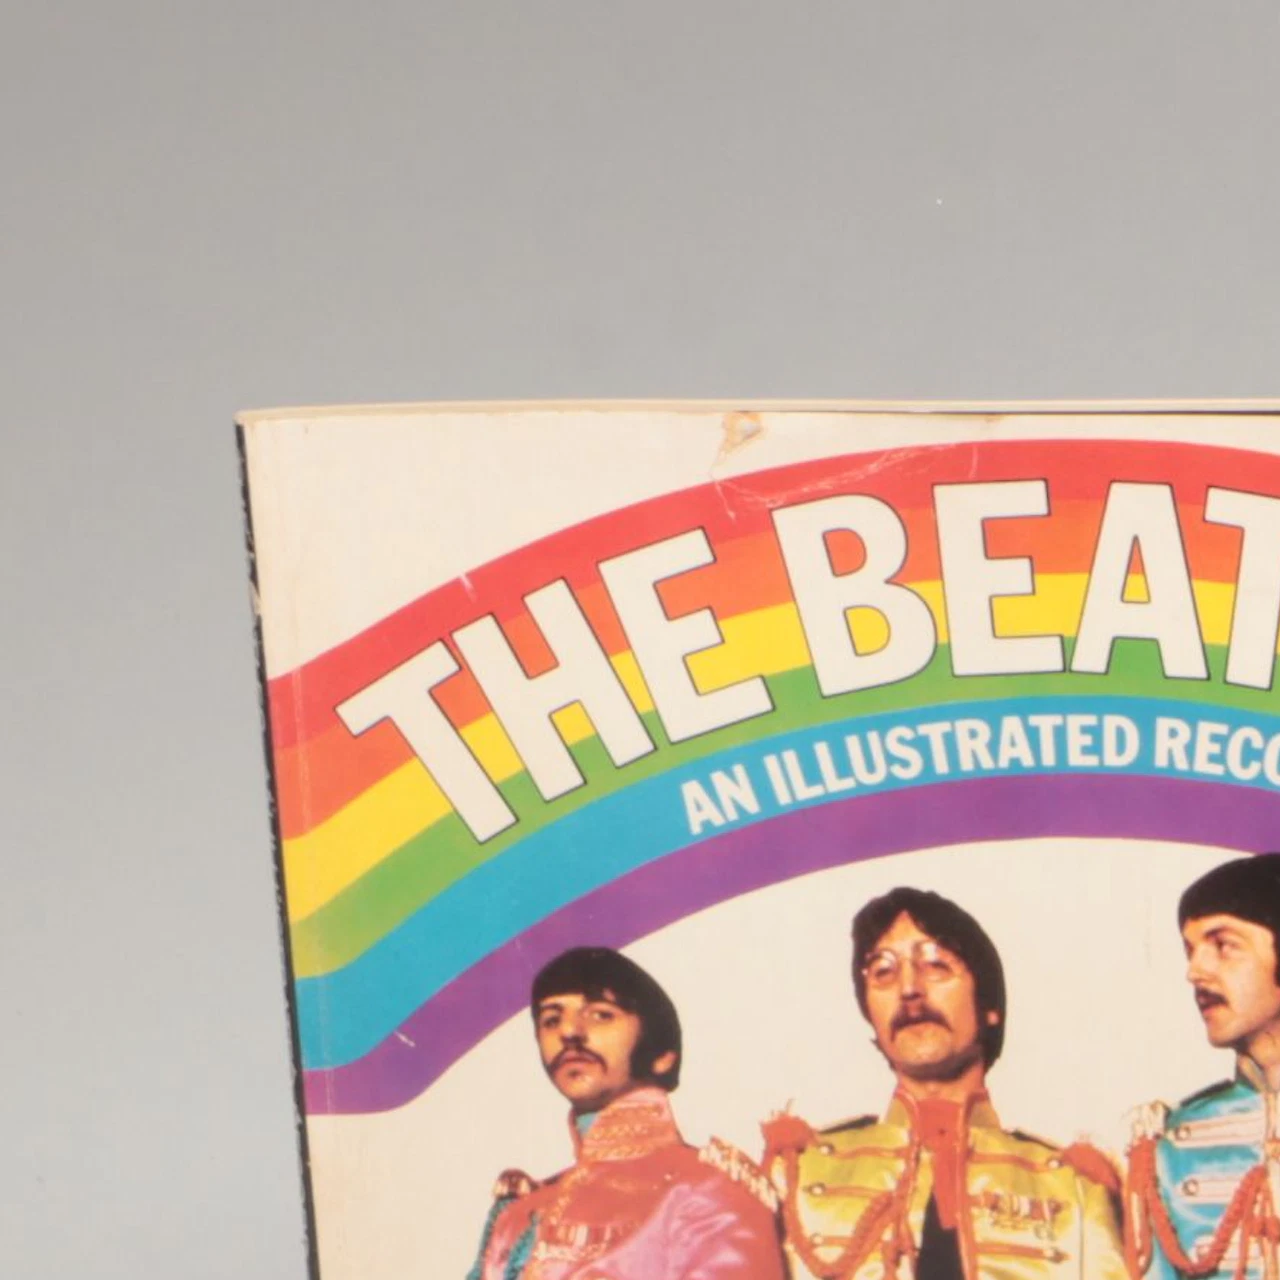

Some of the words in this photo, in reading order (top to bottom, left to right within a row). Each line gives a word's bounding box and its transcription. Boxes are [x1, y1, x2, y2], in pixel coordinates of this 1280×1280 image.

[333, 526, 774, 847] THE
[680, 760, 761, 834] AN
[769, 711, 1142, 808] ILLUSTRATED
